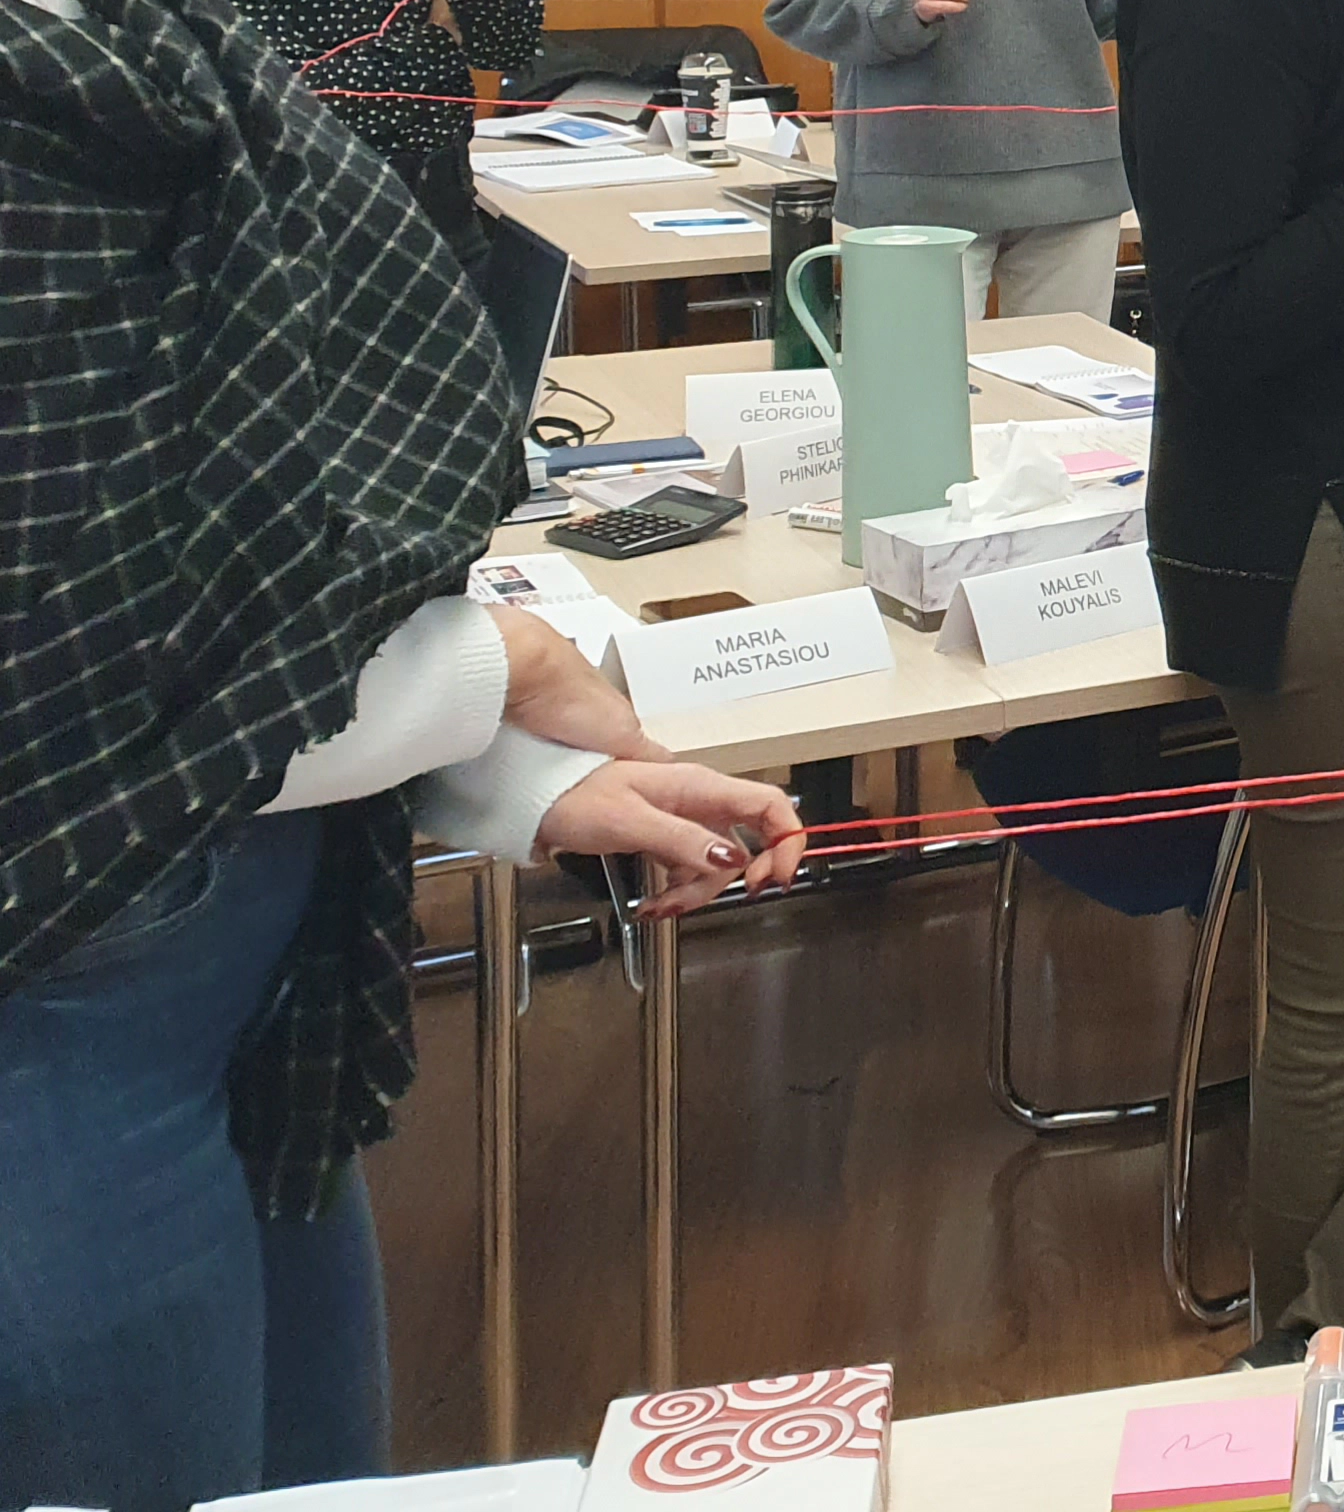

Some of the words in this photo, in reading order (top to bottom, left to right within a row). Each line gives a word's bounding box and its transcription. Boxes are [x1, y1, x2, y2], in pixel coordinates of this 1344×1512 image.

[759, 388, 817, 404] ELENA
[740, 405, 836, 422] GEORGIOU
[1040, 570, 1103, 597] MALEVI
[1038, 588, 1122, 621] KOUYALIS
[715, 627, 787, 655] MARIA
[693, 641, 830, 684] ANASTASIOU
